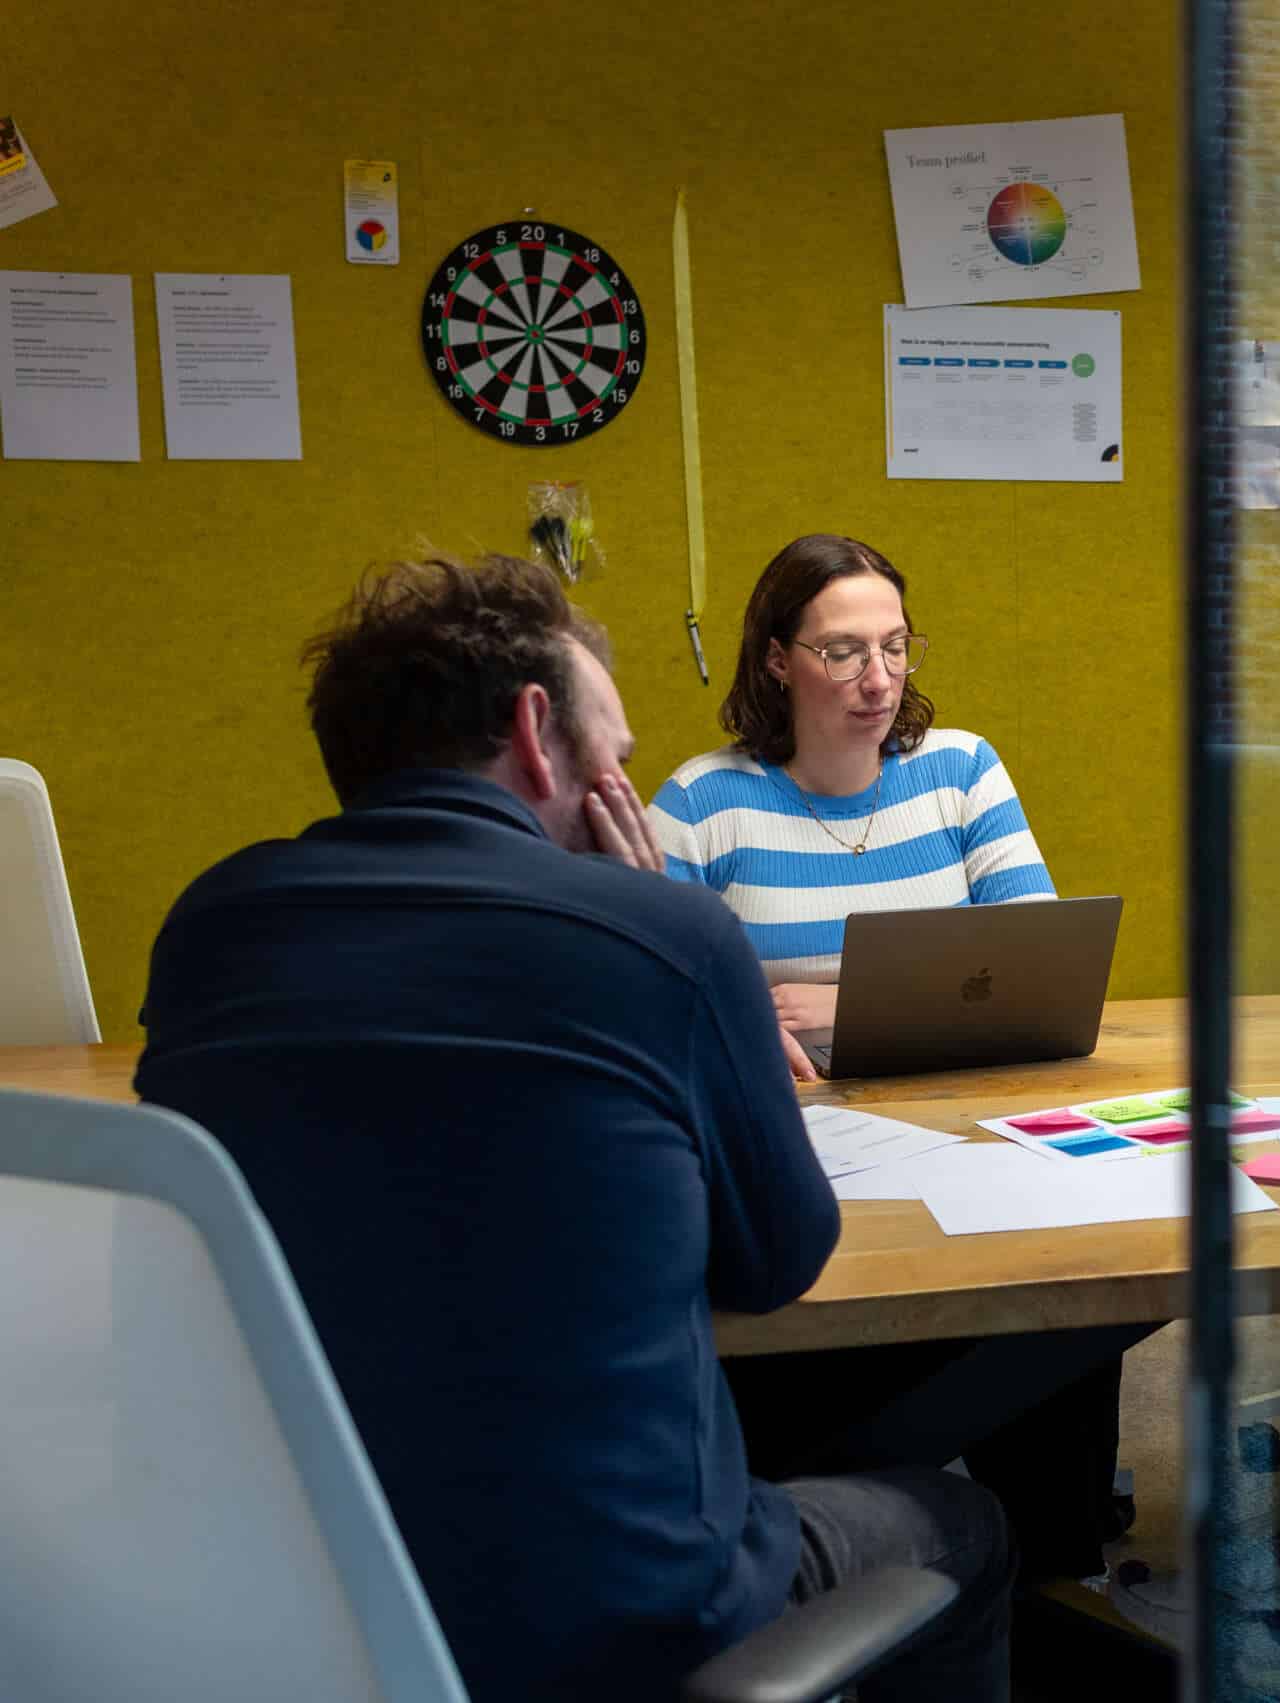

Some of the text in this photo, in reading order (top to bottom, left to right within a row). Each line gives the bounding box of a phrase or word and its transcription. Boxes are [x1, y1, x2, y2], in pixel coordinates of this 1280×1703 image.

[497, 231, 506, 245] 5
[521, 226, 545, 241] 20
[557, 233, 565, 248] 1
[463, 244, 479, 258] 12
[585, 248, 599, 262] 18
[447, 267, 457, 282] 9
[610, 272, 620, 287] 4
[430, 294, 446, 306] 14
[623, 300, 637, 314] 13
[427, 324, 442, 338] 11
[629, 330, 640, 344] 6
[437, 356, 447, 370] 8
[625, 359, 640, 374] 10
[449, 384, 463, 398] 16
[612, 389, 626, 403] 15
[475, 407, 485, 421] 7
[593, 408, 603, 423] 2
[499, 421, 515, 436] 19
[535, 426, 546, 441] 3
[562, 423, 579, 437] 17
